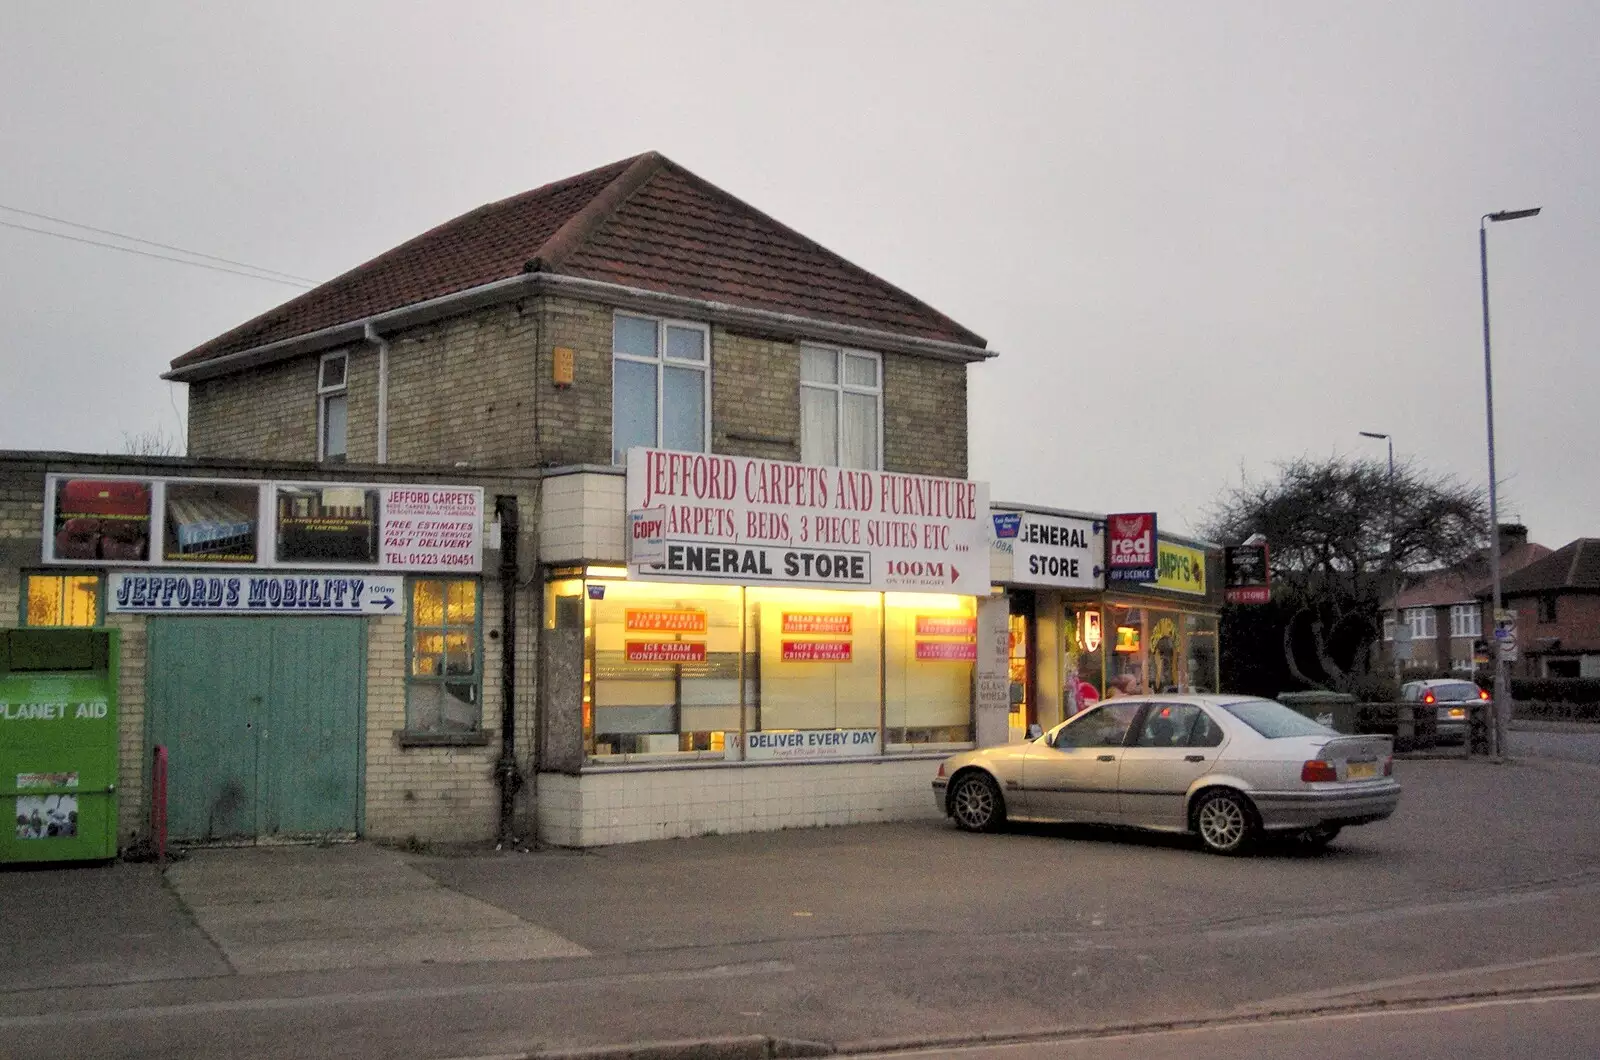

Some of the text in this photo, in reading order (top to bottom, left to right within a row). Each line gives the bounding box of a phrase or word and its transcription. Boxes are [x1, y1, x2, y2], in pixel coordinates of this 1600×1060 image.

[643, 451, 977, 521] JEFFORD CARPETS AND FURNITURE
[388, 491, 475, 505] JEFFORD CARPETS
[385, 520, 474, 531] FREE ESTIMATES
[633, 520, 663, 539] COPY
[658, 504, 739, 545] ARPETS,
[746, 510, 793, 547] BEDS,
[800, 515, 809, 543] 3
[815, 516, 861, 545] PIECE
[867, 519, 918, 549] SUITES
[923, 524, 950, 551] ETC
[408, 530, 438, 538] FITTING
[384, 538, 473, 549] FAST DELIVERY
[1111, 530, 1151, 555] red
[386, 553, 475, 566] TEL: 01223 420451
[650, 546, 864, 580] ENERAL STORE
[1029, 554, 1080, 578] STORE
[1111, 554, 1150, 564] SQUARE
[885, 560, 945, 577] 100M
[1111, 570, 1151, 580] OFF LICENCE
[116, 577, 365, 608] JEFFORD'S MOBILITY
[369, 585, 395, 594] 100m
[644, 643, 691, 652] ICE CREAM
[793, 643, 812, 651] SOFT
[630, 652, 703, 661] CONFECTIONERY
[76, 702, 108, 719] AID
[750, 733, 804, 748] DELIVER
[808, 732, 848, 746] EVERY
[852, 731, 877, 745] DAY
